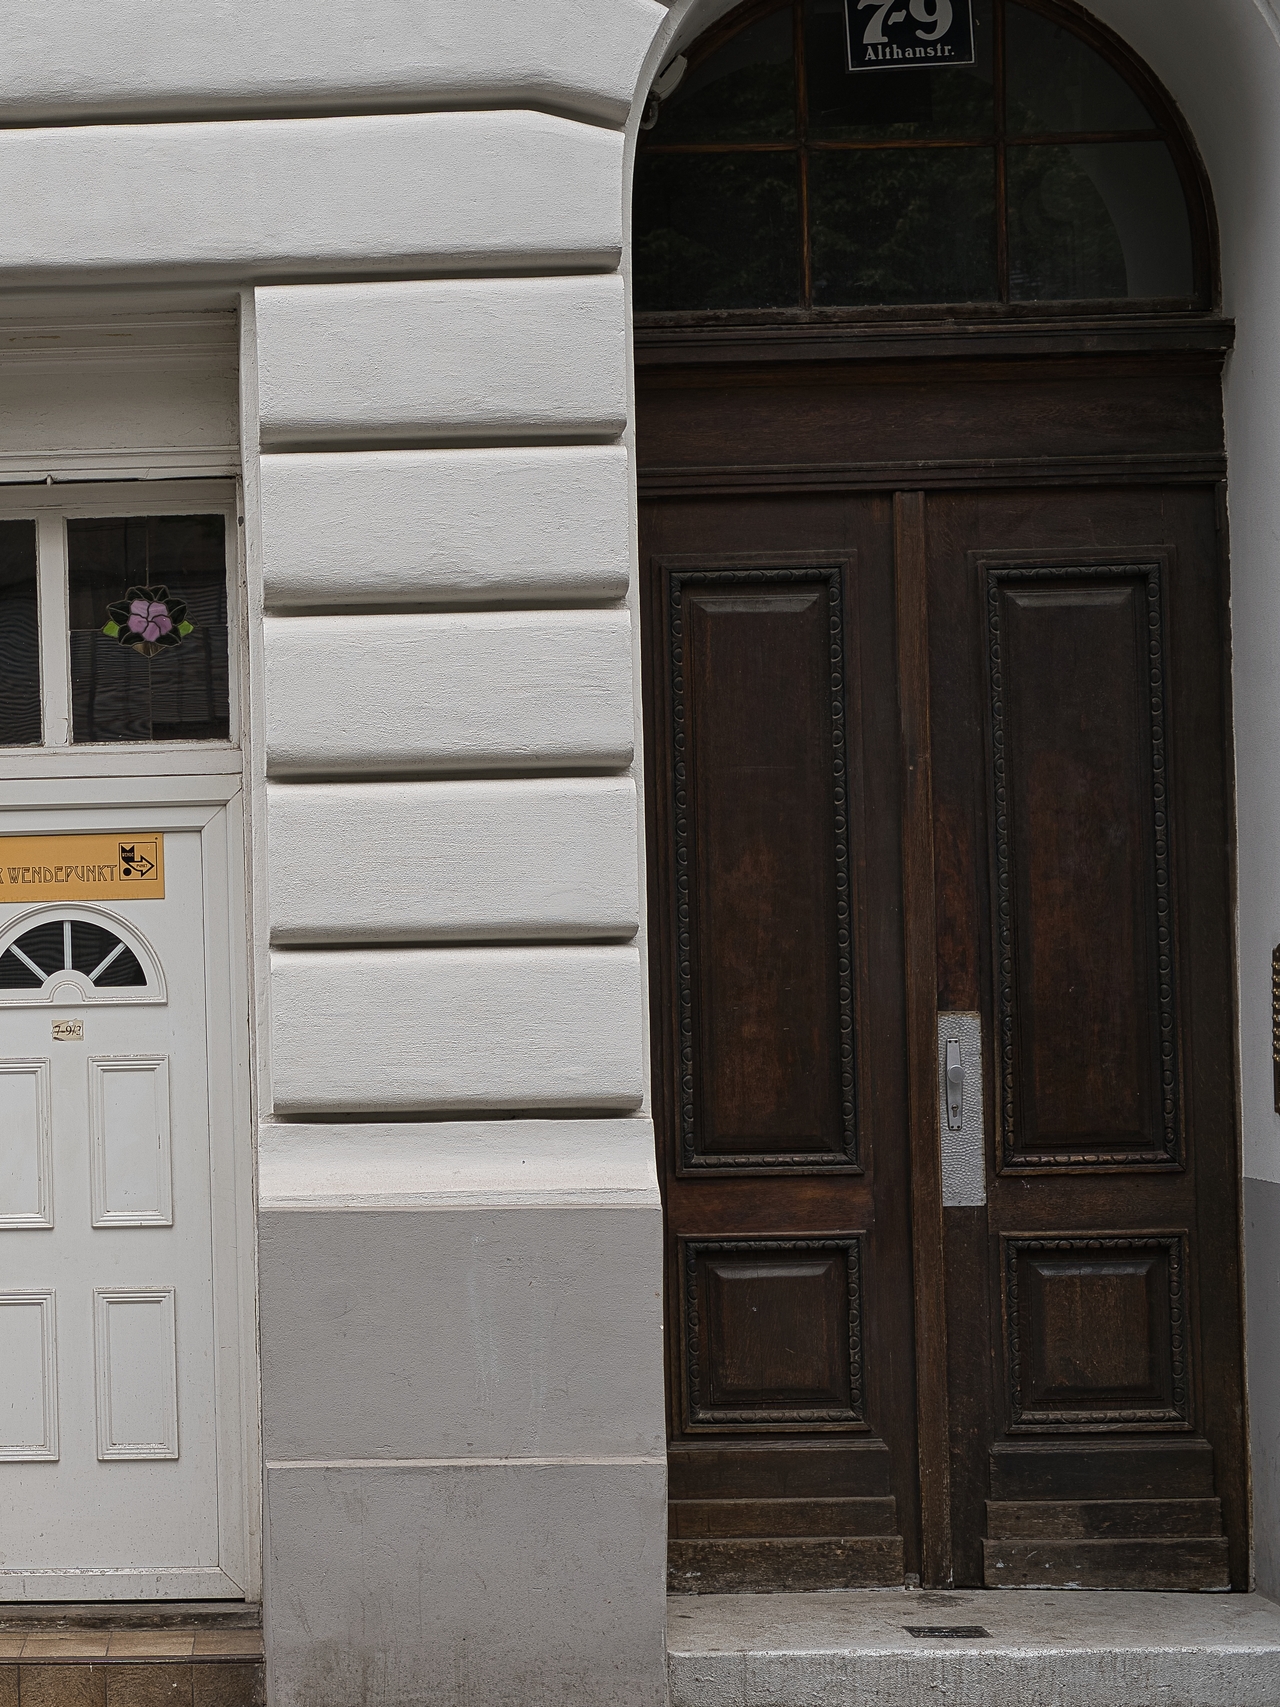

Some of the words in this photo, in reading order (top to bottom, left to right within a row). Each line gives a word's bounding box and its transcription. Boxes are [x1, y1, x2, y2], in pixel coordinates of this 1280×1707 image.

[857, 0, 953, 44] 7-9
[864, 43, 955, 60] Althanstr.
[7, 864, 117, 884] WENDEPUNKT
